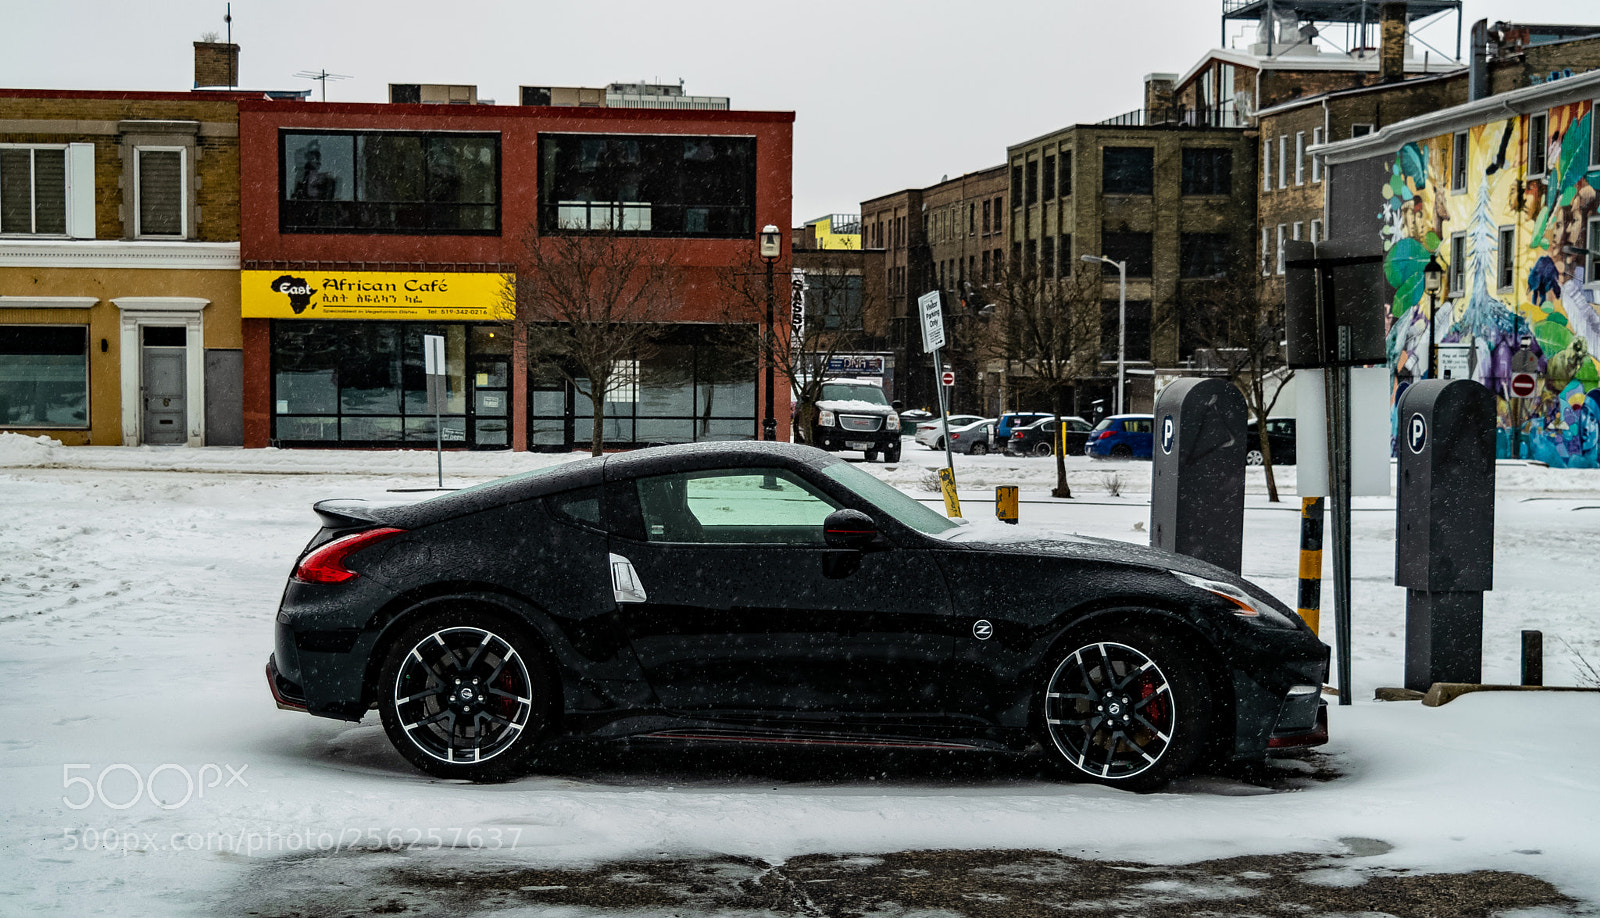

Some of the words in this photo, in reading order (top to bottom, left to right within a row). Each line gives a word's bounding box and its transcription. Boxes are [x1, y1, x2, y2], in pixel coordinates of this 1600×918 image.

[279, 282, 312, 295] East
[322, 278, 397, 292] African
[404, 279, 448, 292] Café
[792, 280, 803, 336] SASSY
[1164, 419, 1173, 447] P
[1412, 419, 1423, 447] P
